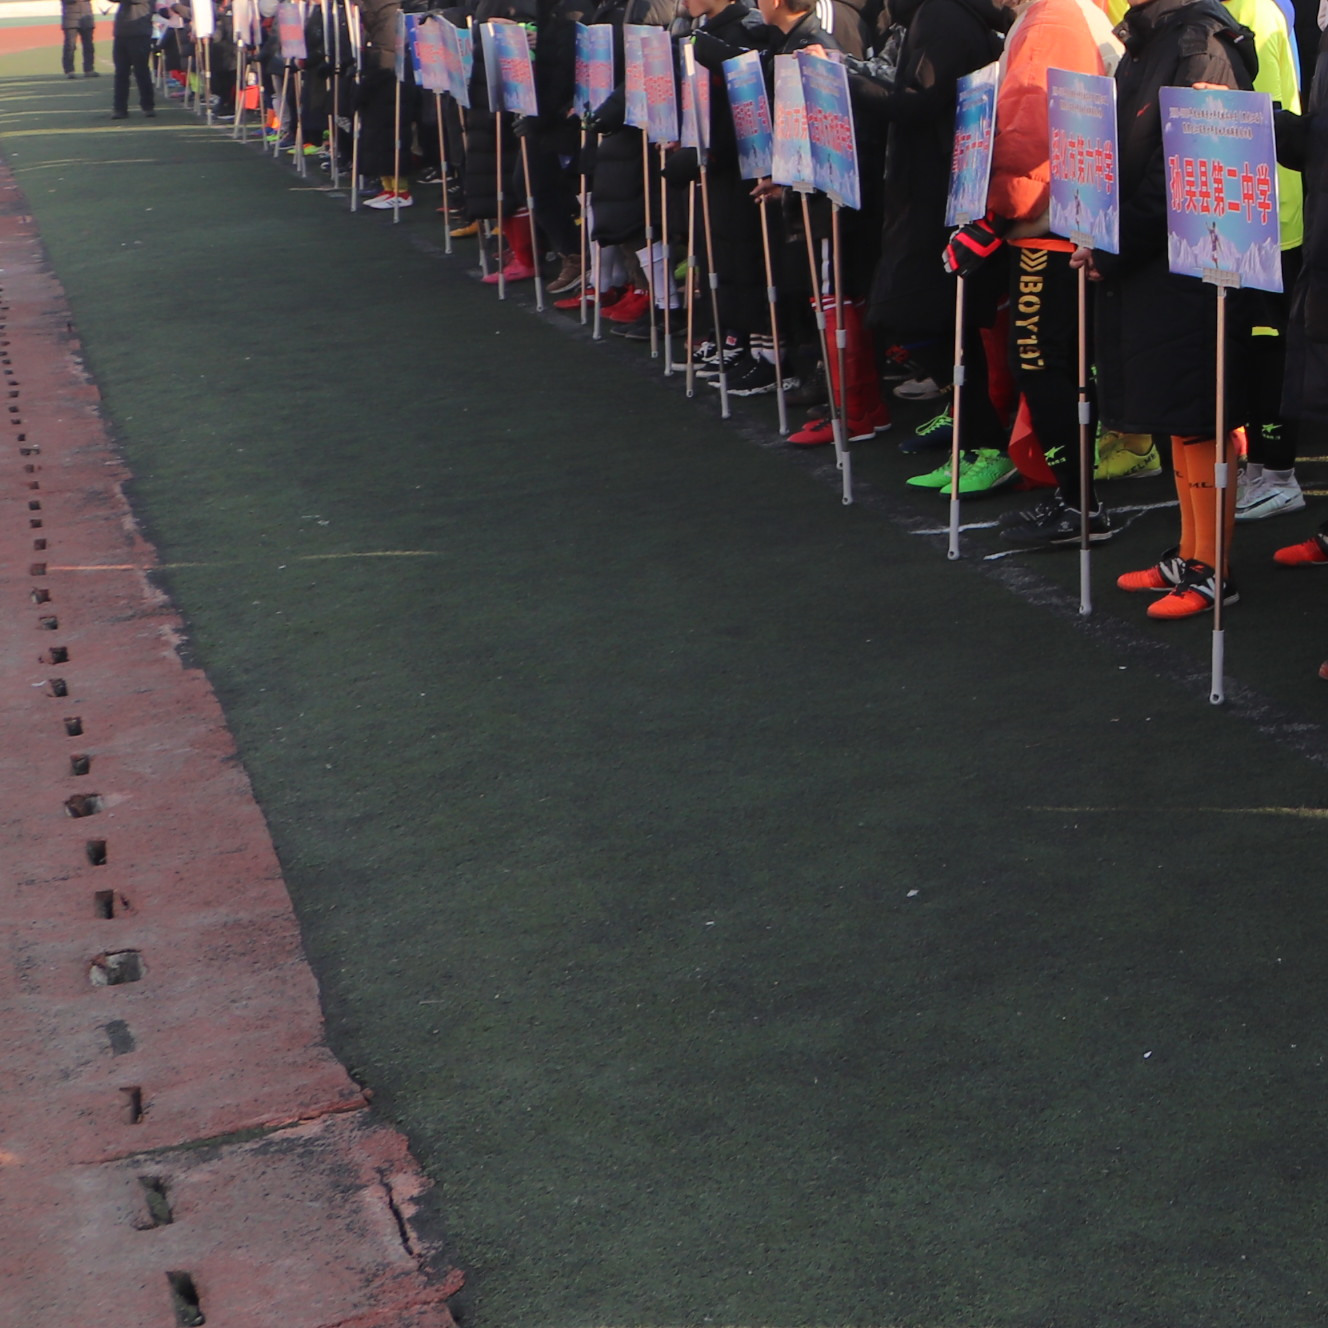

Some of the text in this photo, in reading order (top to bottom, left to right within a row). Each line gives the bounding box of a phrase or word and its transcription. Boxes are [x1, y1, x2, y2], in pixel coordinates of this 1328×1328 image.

[1168, 155, 1272, 225] 孙吴县第二中学
